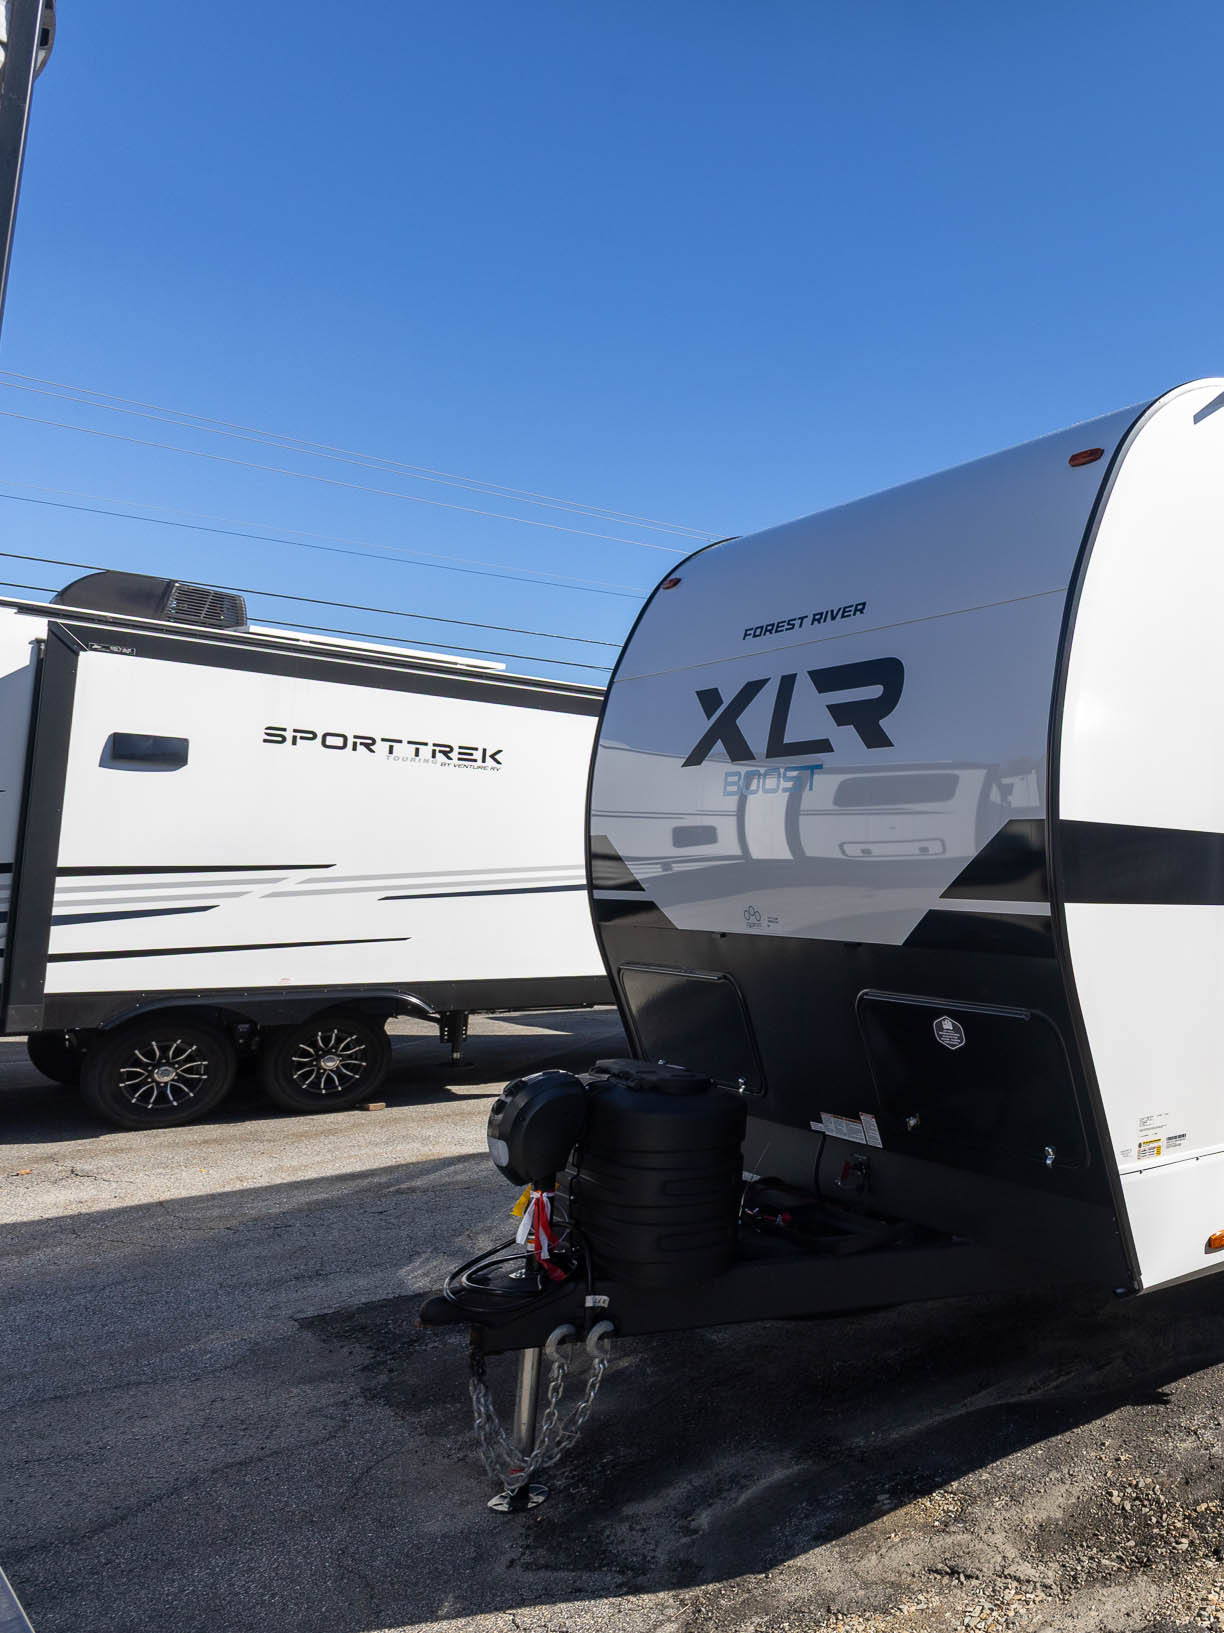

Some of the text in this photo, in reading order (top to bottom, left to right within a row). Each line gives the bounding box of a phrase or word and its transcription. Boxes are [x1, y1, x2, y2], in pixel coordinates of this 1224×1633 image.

[742, 601, 867, 640] FOREST RIVER
[681, 656, 905, 768] XLR
[262, 726, 504, 765] SPORTTREK
[385, 754, 438, 765] TOURING
[453, 763, 489, 771] VENTURE
[722, 763, 824, 797] BOOST
